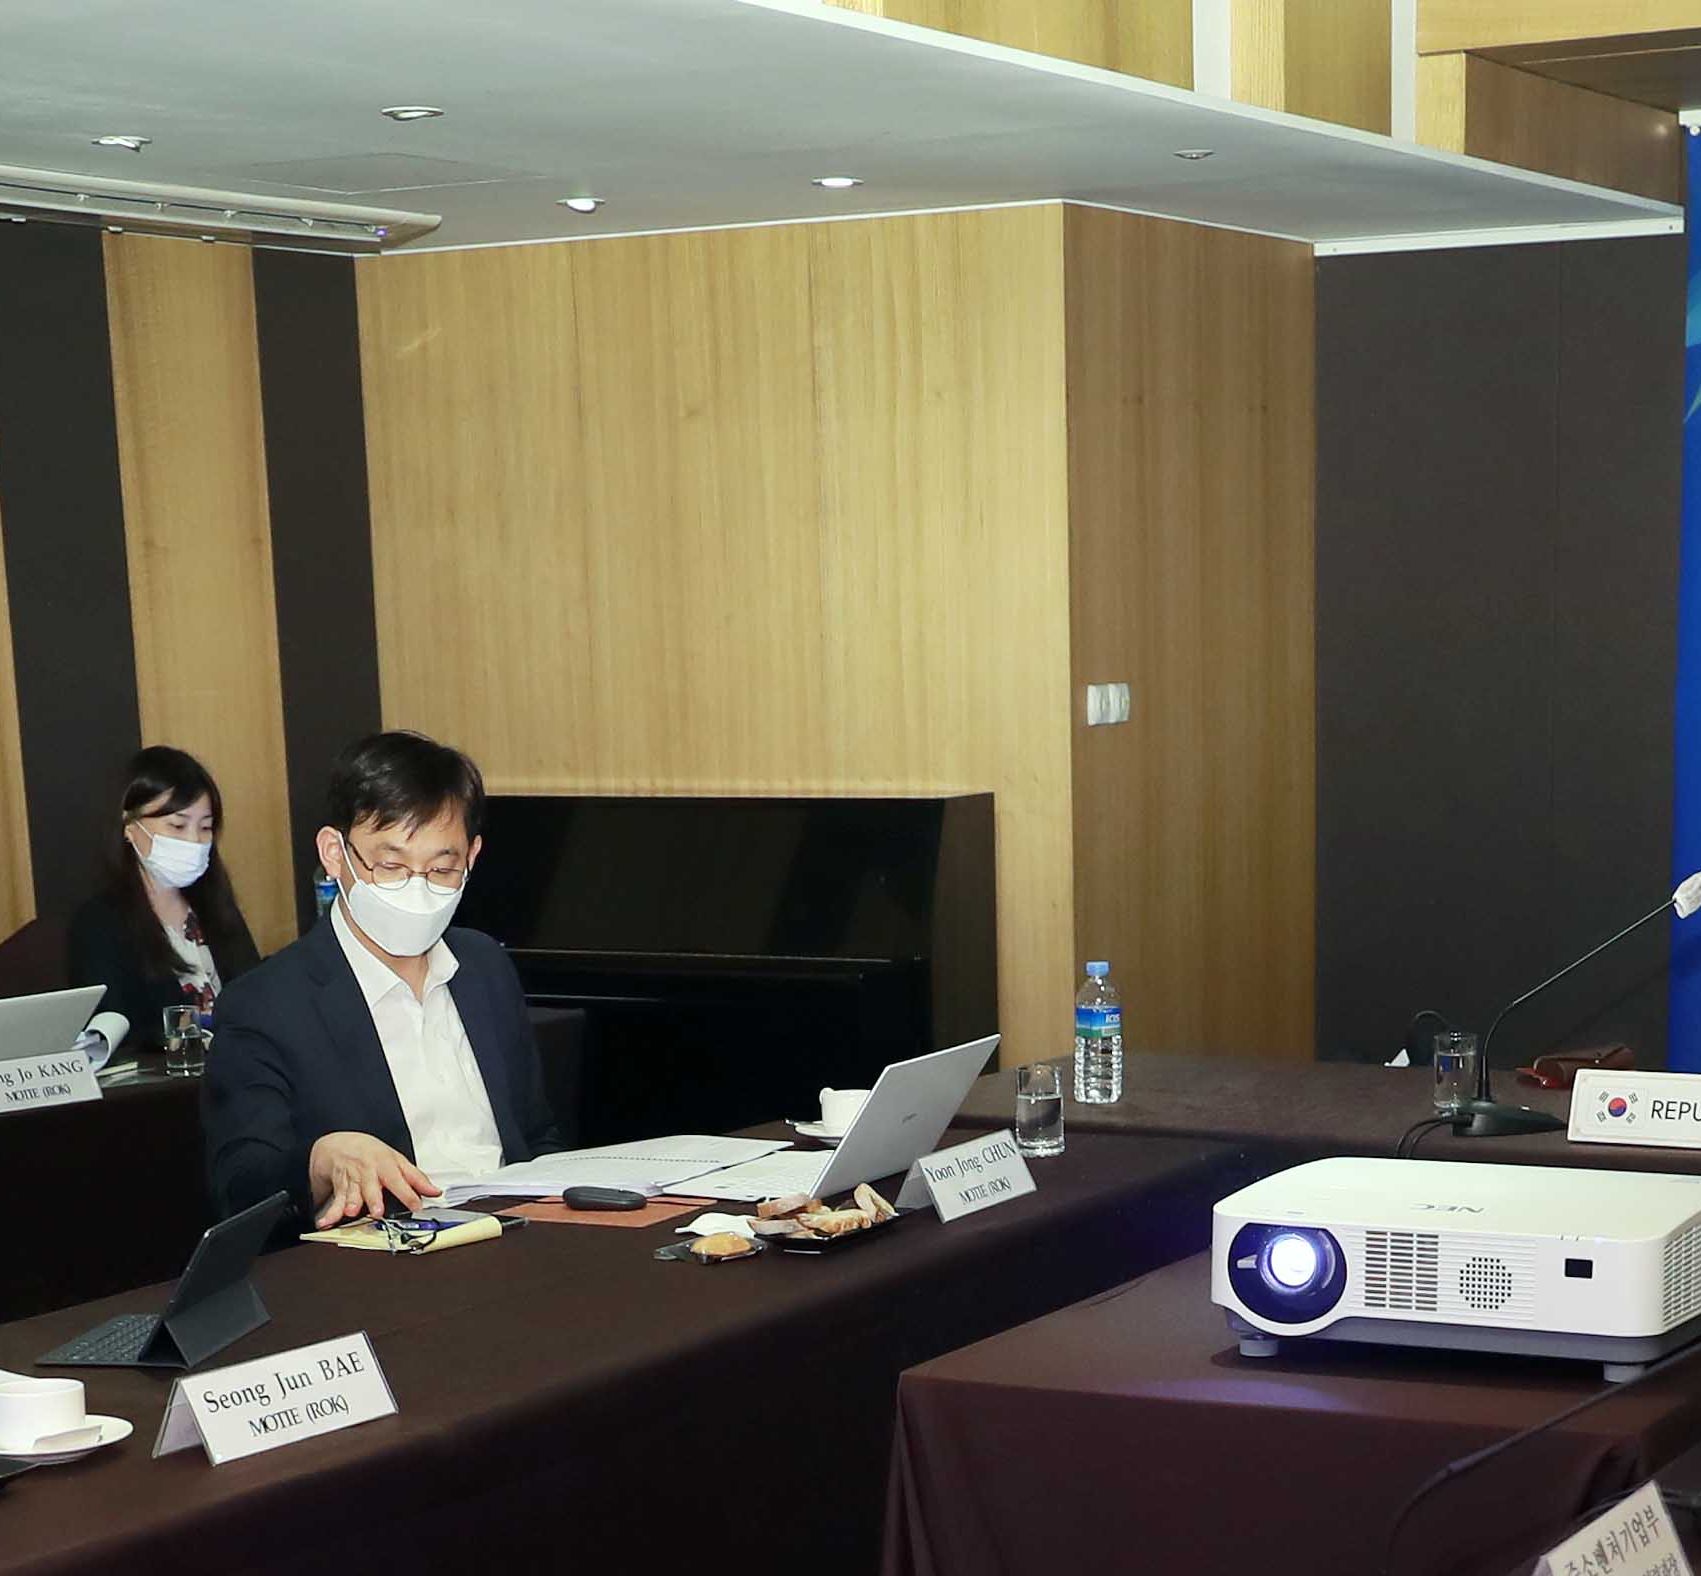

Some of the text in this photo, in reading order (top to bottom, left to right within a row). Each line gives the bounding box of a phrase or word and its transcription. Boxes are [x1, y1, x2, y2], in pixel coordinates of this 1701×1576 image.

[4, 1083, 72, 1103] MOTIE (ROK)
[18, 1067, 33, 1084] Jo
[37, 1060, 83, 1079] KANG
[924, 1139, 1018, 1184] Yoon Jong CHUN
[202, 1351, 365, 1413] Seong Jun BAE
[248, 1394, 351, 1438] MOTIE (ROK)
